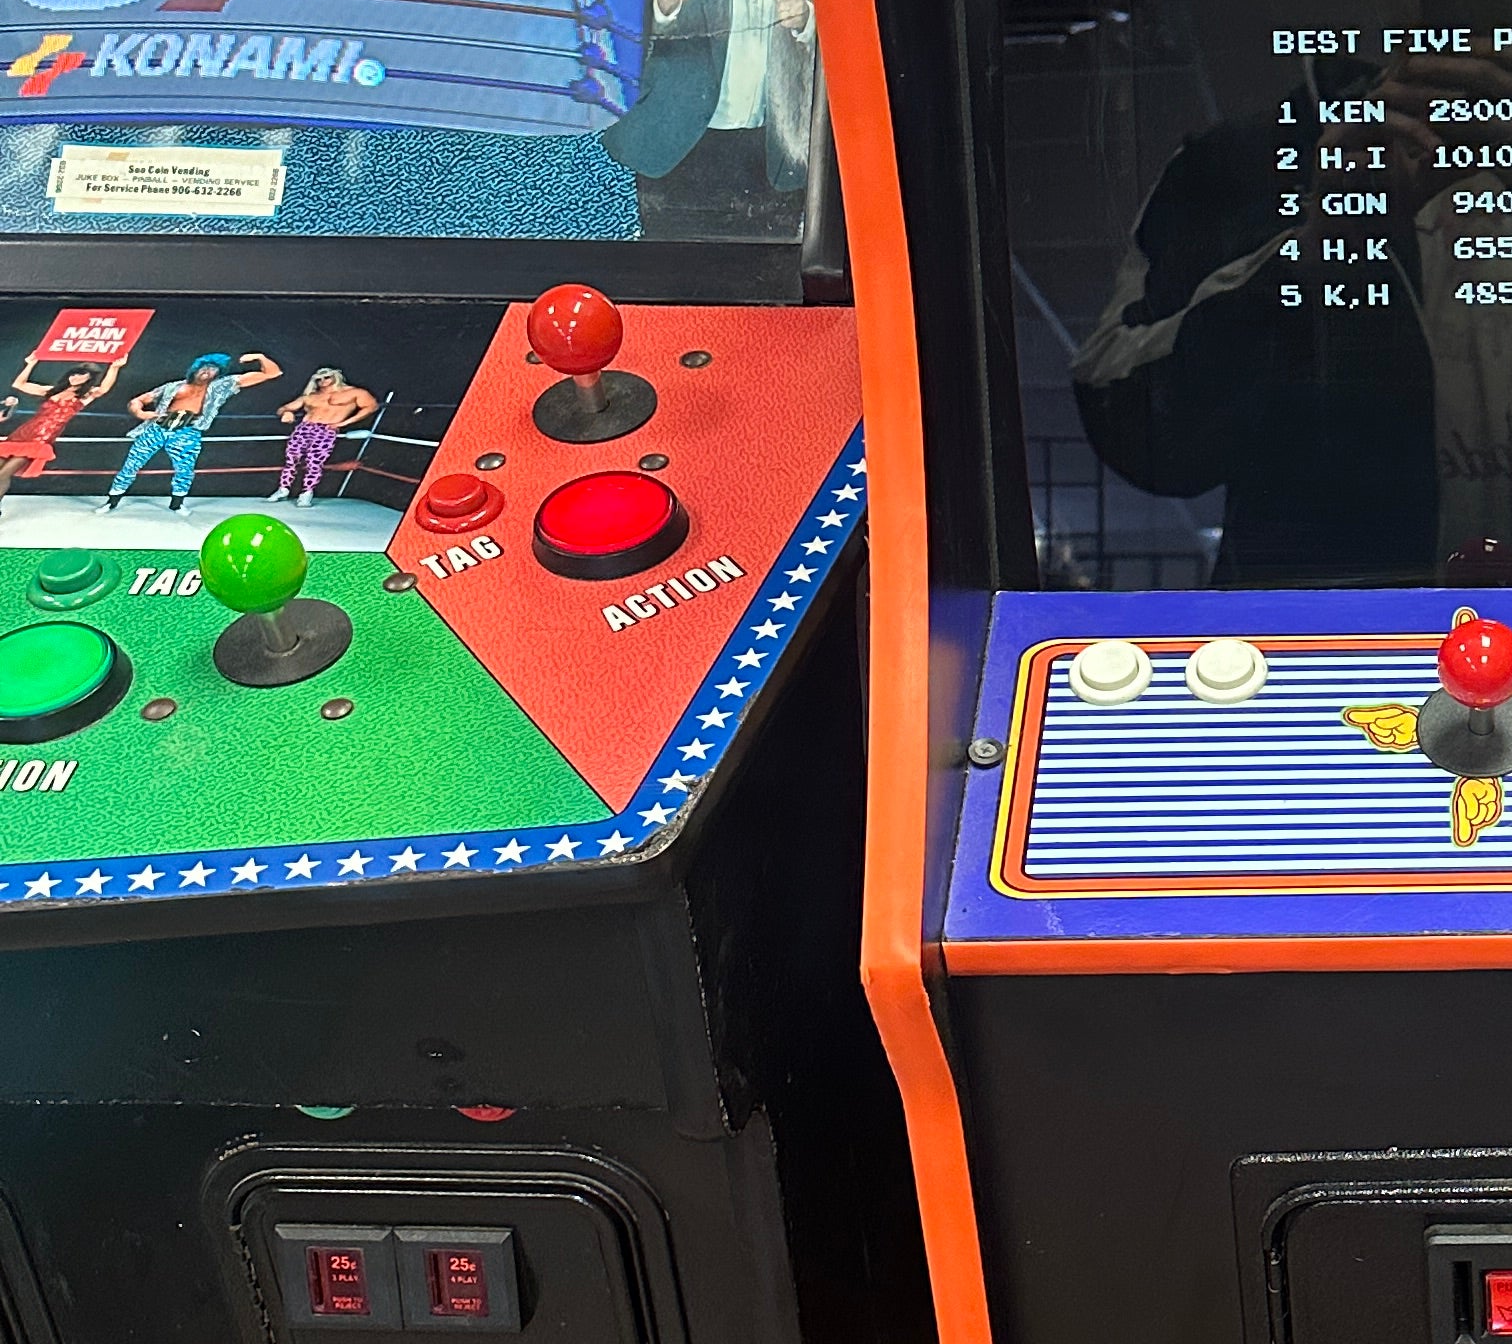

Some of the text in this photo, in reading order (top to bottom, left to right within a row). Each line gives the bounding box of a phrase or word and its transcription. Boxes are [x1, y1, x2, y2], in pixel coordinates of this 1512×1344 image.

[1272, 29, 1361, 55] BEST
[1383, 28, 1472, 54] FIVE
[1277, 101, 1298, 124] 1
[1318, 100, 1387, 123] KEN
[1276, 147, 1299, 171] 2
[75, 173, 99, 182] JUKE
[101, 174, 120, 182] BOX
[148, 165, 170, 175] Coin
[172, 165, 211, 178] Vending
[85, 182, 103, 192] For
[104, 183, 140, 194] Service
[140, 184, 170, 194] Phone
[1278, 193, 1300, 217] 3
[1321, 192, 1388, 216] GON
[1279, 238, 1301, 262] 4
[1280, 284, 1302, 308] 5
[62, 326, 128, 341] MAIN
[88, 317, 118, 327] THE
[48, 339, 125, 354] EVENT
[419, 534, 502, 581] TAG
[127, 567, 202, 596] TAG
[601, 555, 747, 632] ACTION
[0, 758, 79, 792] ION
[338, 1274, 359, 1282] PLAY
[457, 1276, 478, 1284] PLAY
